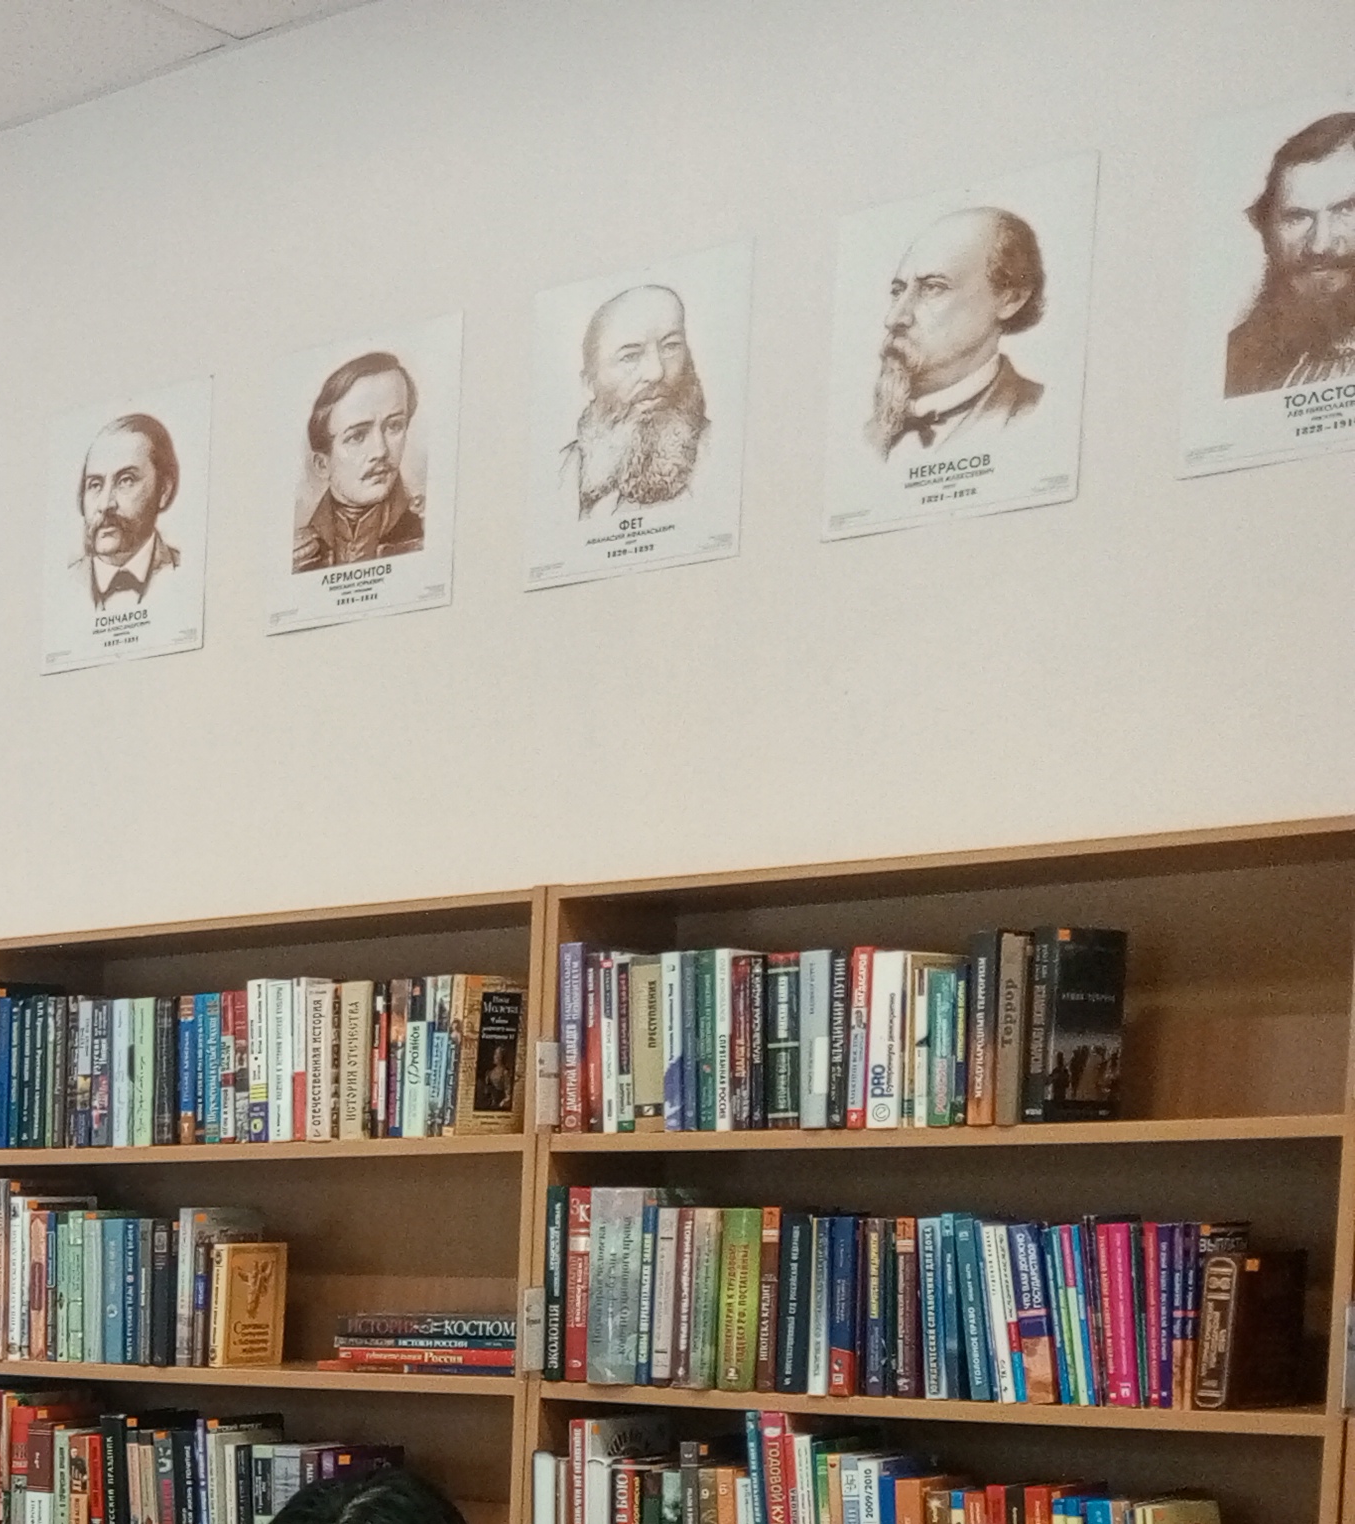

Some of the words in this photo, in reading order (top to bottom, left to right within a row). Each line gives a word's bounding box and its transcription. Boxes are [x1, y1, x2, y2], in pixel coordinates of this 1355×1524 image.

[909, 454, 991, 479] НЕКРАСОВ
[619, 518, 644, 531] ФЕТ
[321, 564, 392, 585] ЛЕРМОНТОВ
[95, 609, 148, 627] ГОНЧАРОВ
[647, 980, 657, 1048] ПРЕСТУПЛЕНИЯ
[1001, 978, 1017, 1048] Террор
[345, 1071, 357, 1121] ИСТОРИЯ
[1017, 1232, 1028, 1272] ДОЛЖНО
[1022, 1273, 1031, 1291] ВАМ
[1028, 1243, 1042, 1309] ГОСУДАРСТВО?
[1023, 1293, 1032, 1309] ЧТО
[768, 1441, 784, 1503] ГОДОВОЙ
[616, 1473, 628, 1509] БОЮ
[864, 1468, 874, 1518] 2009/2010
[616, 1514, 628, 1522] В
